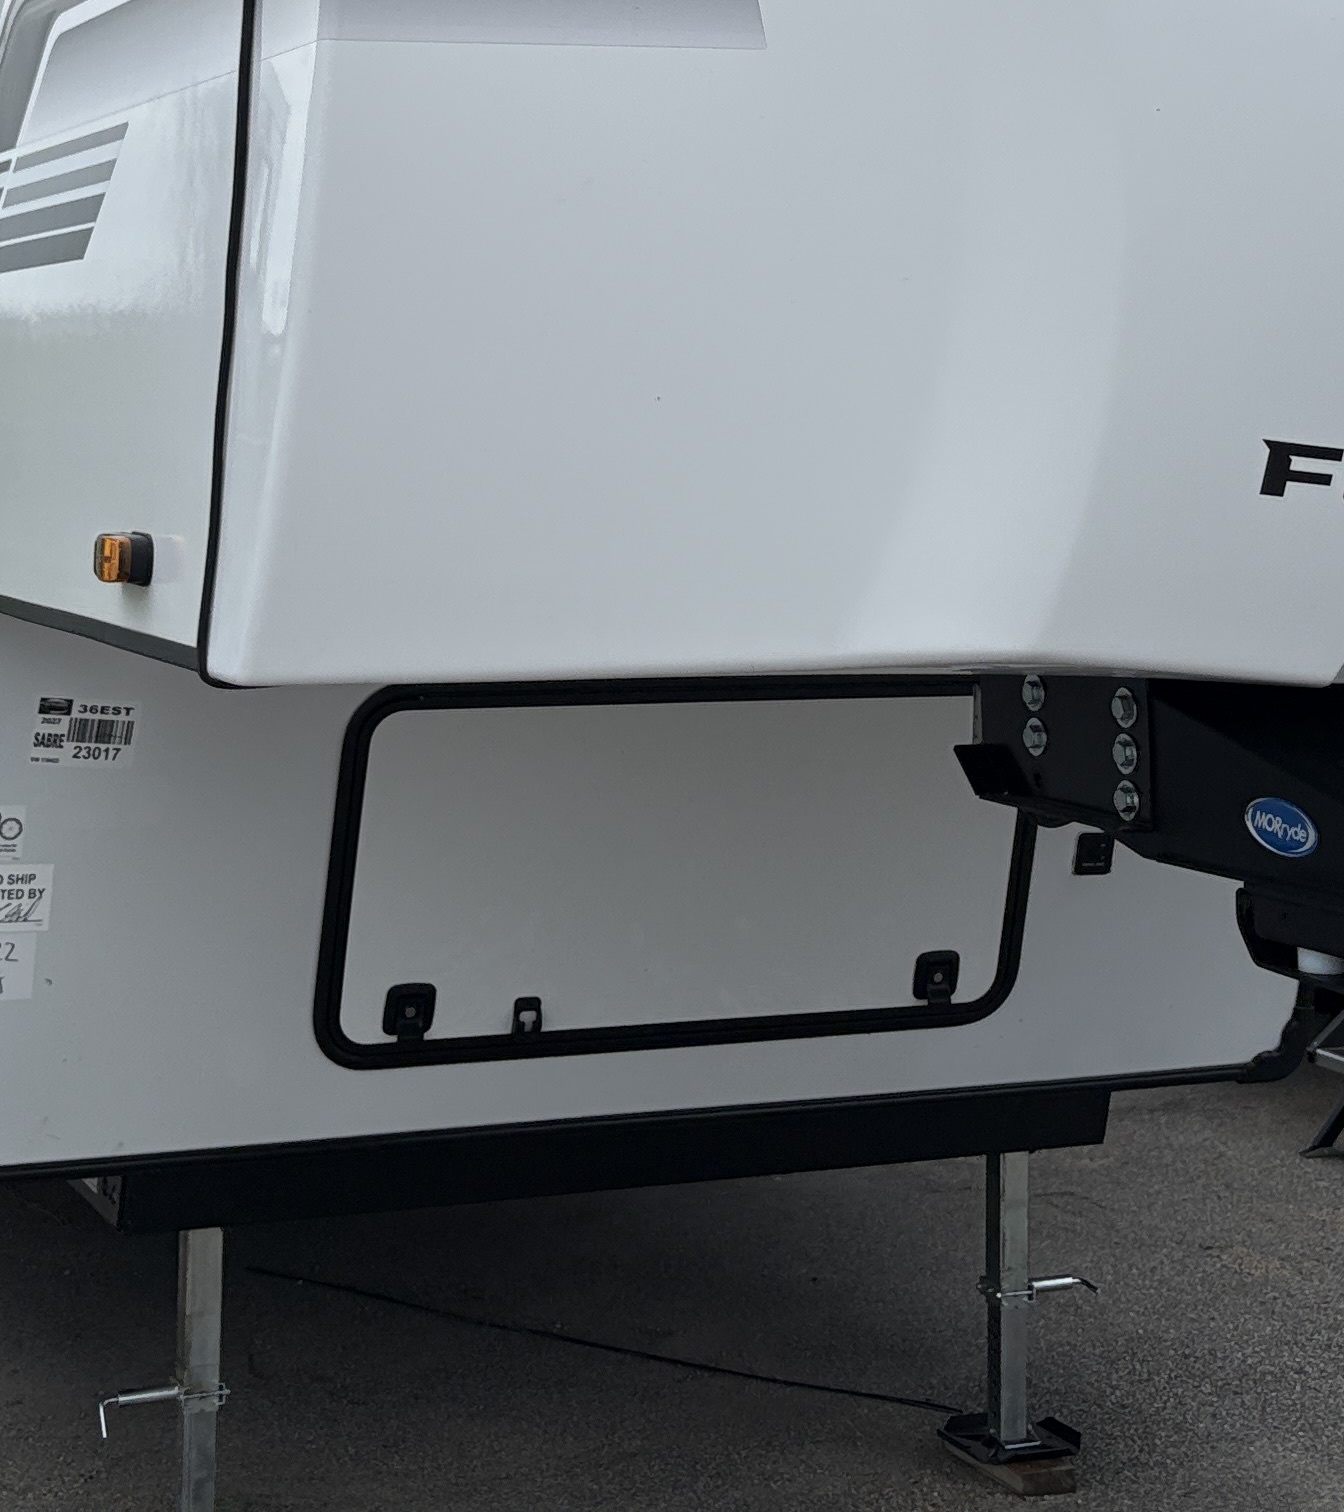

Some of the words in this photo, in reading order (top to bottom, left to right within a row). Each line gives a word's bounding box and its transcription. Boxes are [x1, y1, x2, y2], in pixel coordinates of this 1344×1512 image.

[78, 704, 136, 717] 36EST
[33, 732, 66, 749] SABRE
[72, 745, 122, 761] 23017
[1253, 810, 1308, 843] MORryde
[7, 873, 37, 885] SHIP
[27, 888, 47, 900] BY
